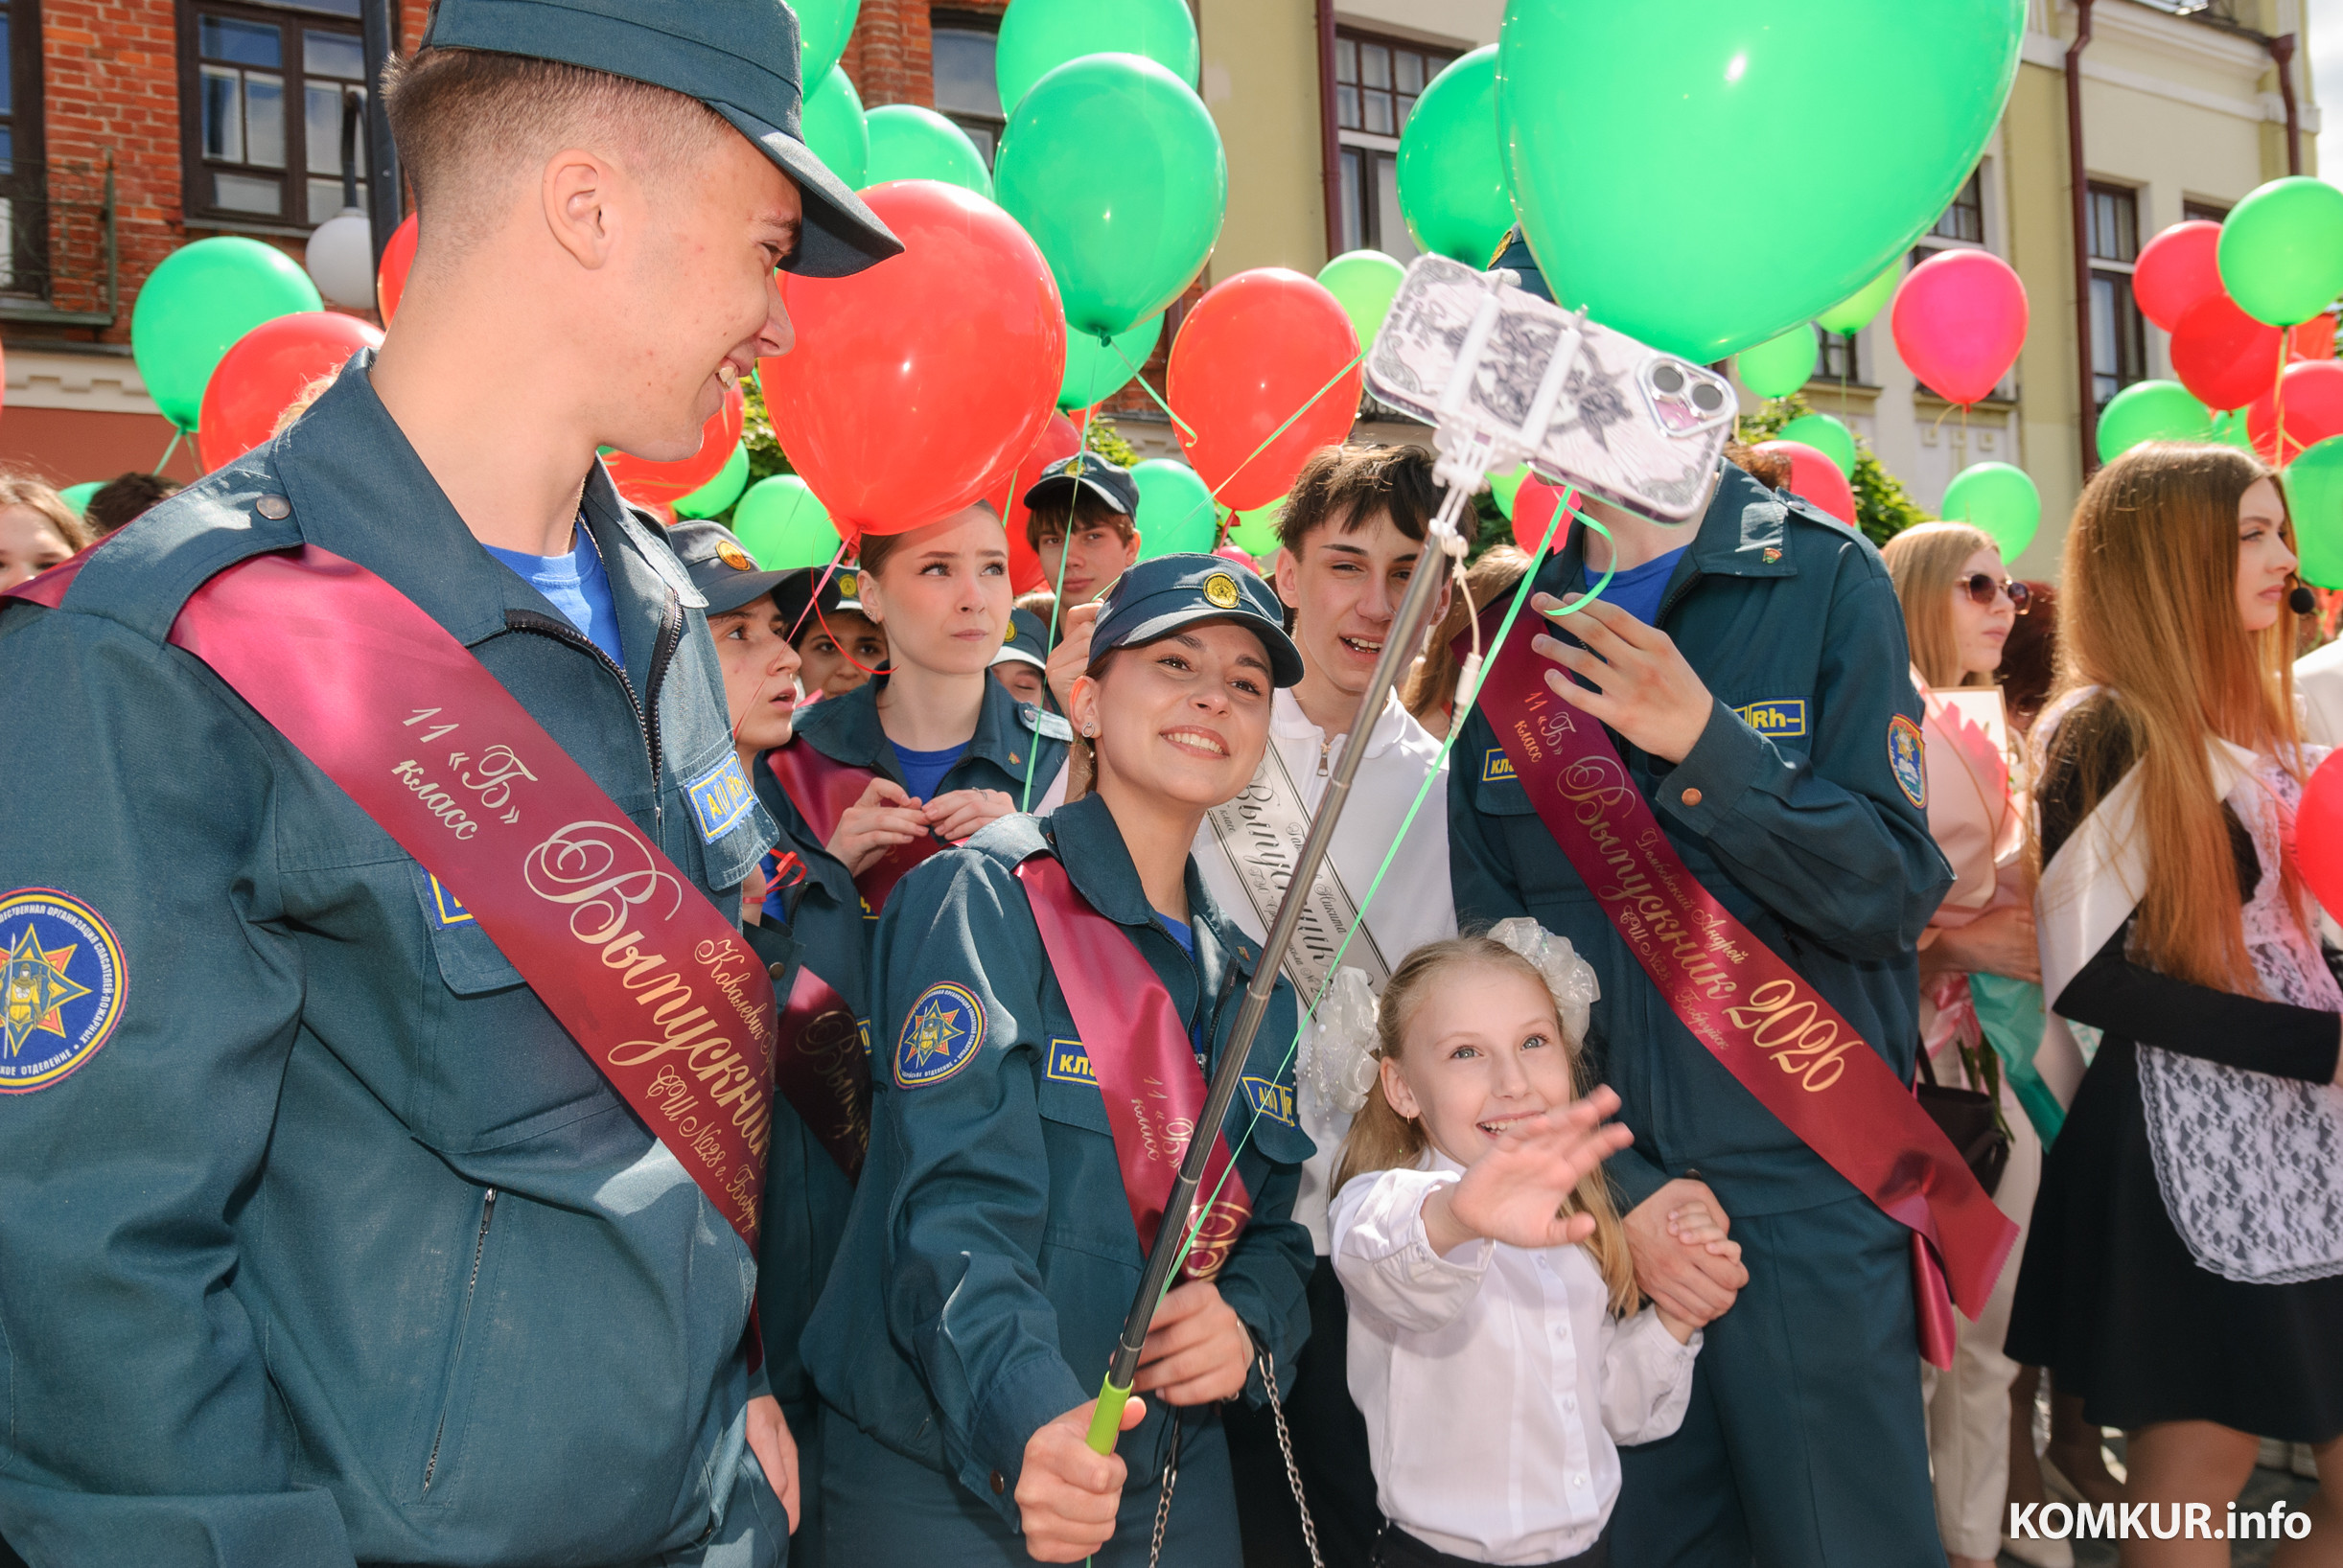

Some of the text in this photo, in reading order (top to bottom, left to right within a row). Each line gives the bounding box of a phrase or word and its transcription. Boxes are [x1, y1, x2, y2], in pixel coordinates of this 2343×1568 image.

[1514, 720, 1543, 763] класс
[1524, 691, 1576, 755] 11 «Б»
[391, 760, 477, 840] класс
[403, 707, 538, 824] 11 «Б»
[47, 907, 97, 945] ОРГАНИЗАЦИЯ
[1314, 884, 1347, 935] Никита
[1557, 755, 1864, 1092] Выпускник 2026
[1691, 909, 1749, 964] Андрей
[524, 820, 773, 1168] Выпускник
[695, 939, 765, 1040] Ковалевич
[1620, 905, 1649, 943] СШ
[1675, 986, 1729, 1050] Бобруйск
[20, 1049, 73, 1075] ОТДЕЛЕНИЕ
[645, 1064, 699, 1121] СШ
[679, 1116, 726, 1168] №28
[1131, 1097, 1160, 1161] класс
[1143, 1074, 1195, 1168] 11 «Б»
